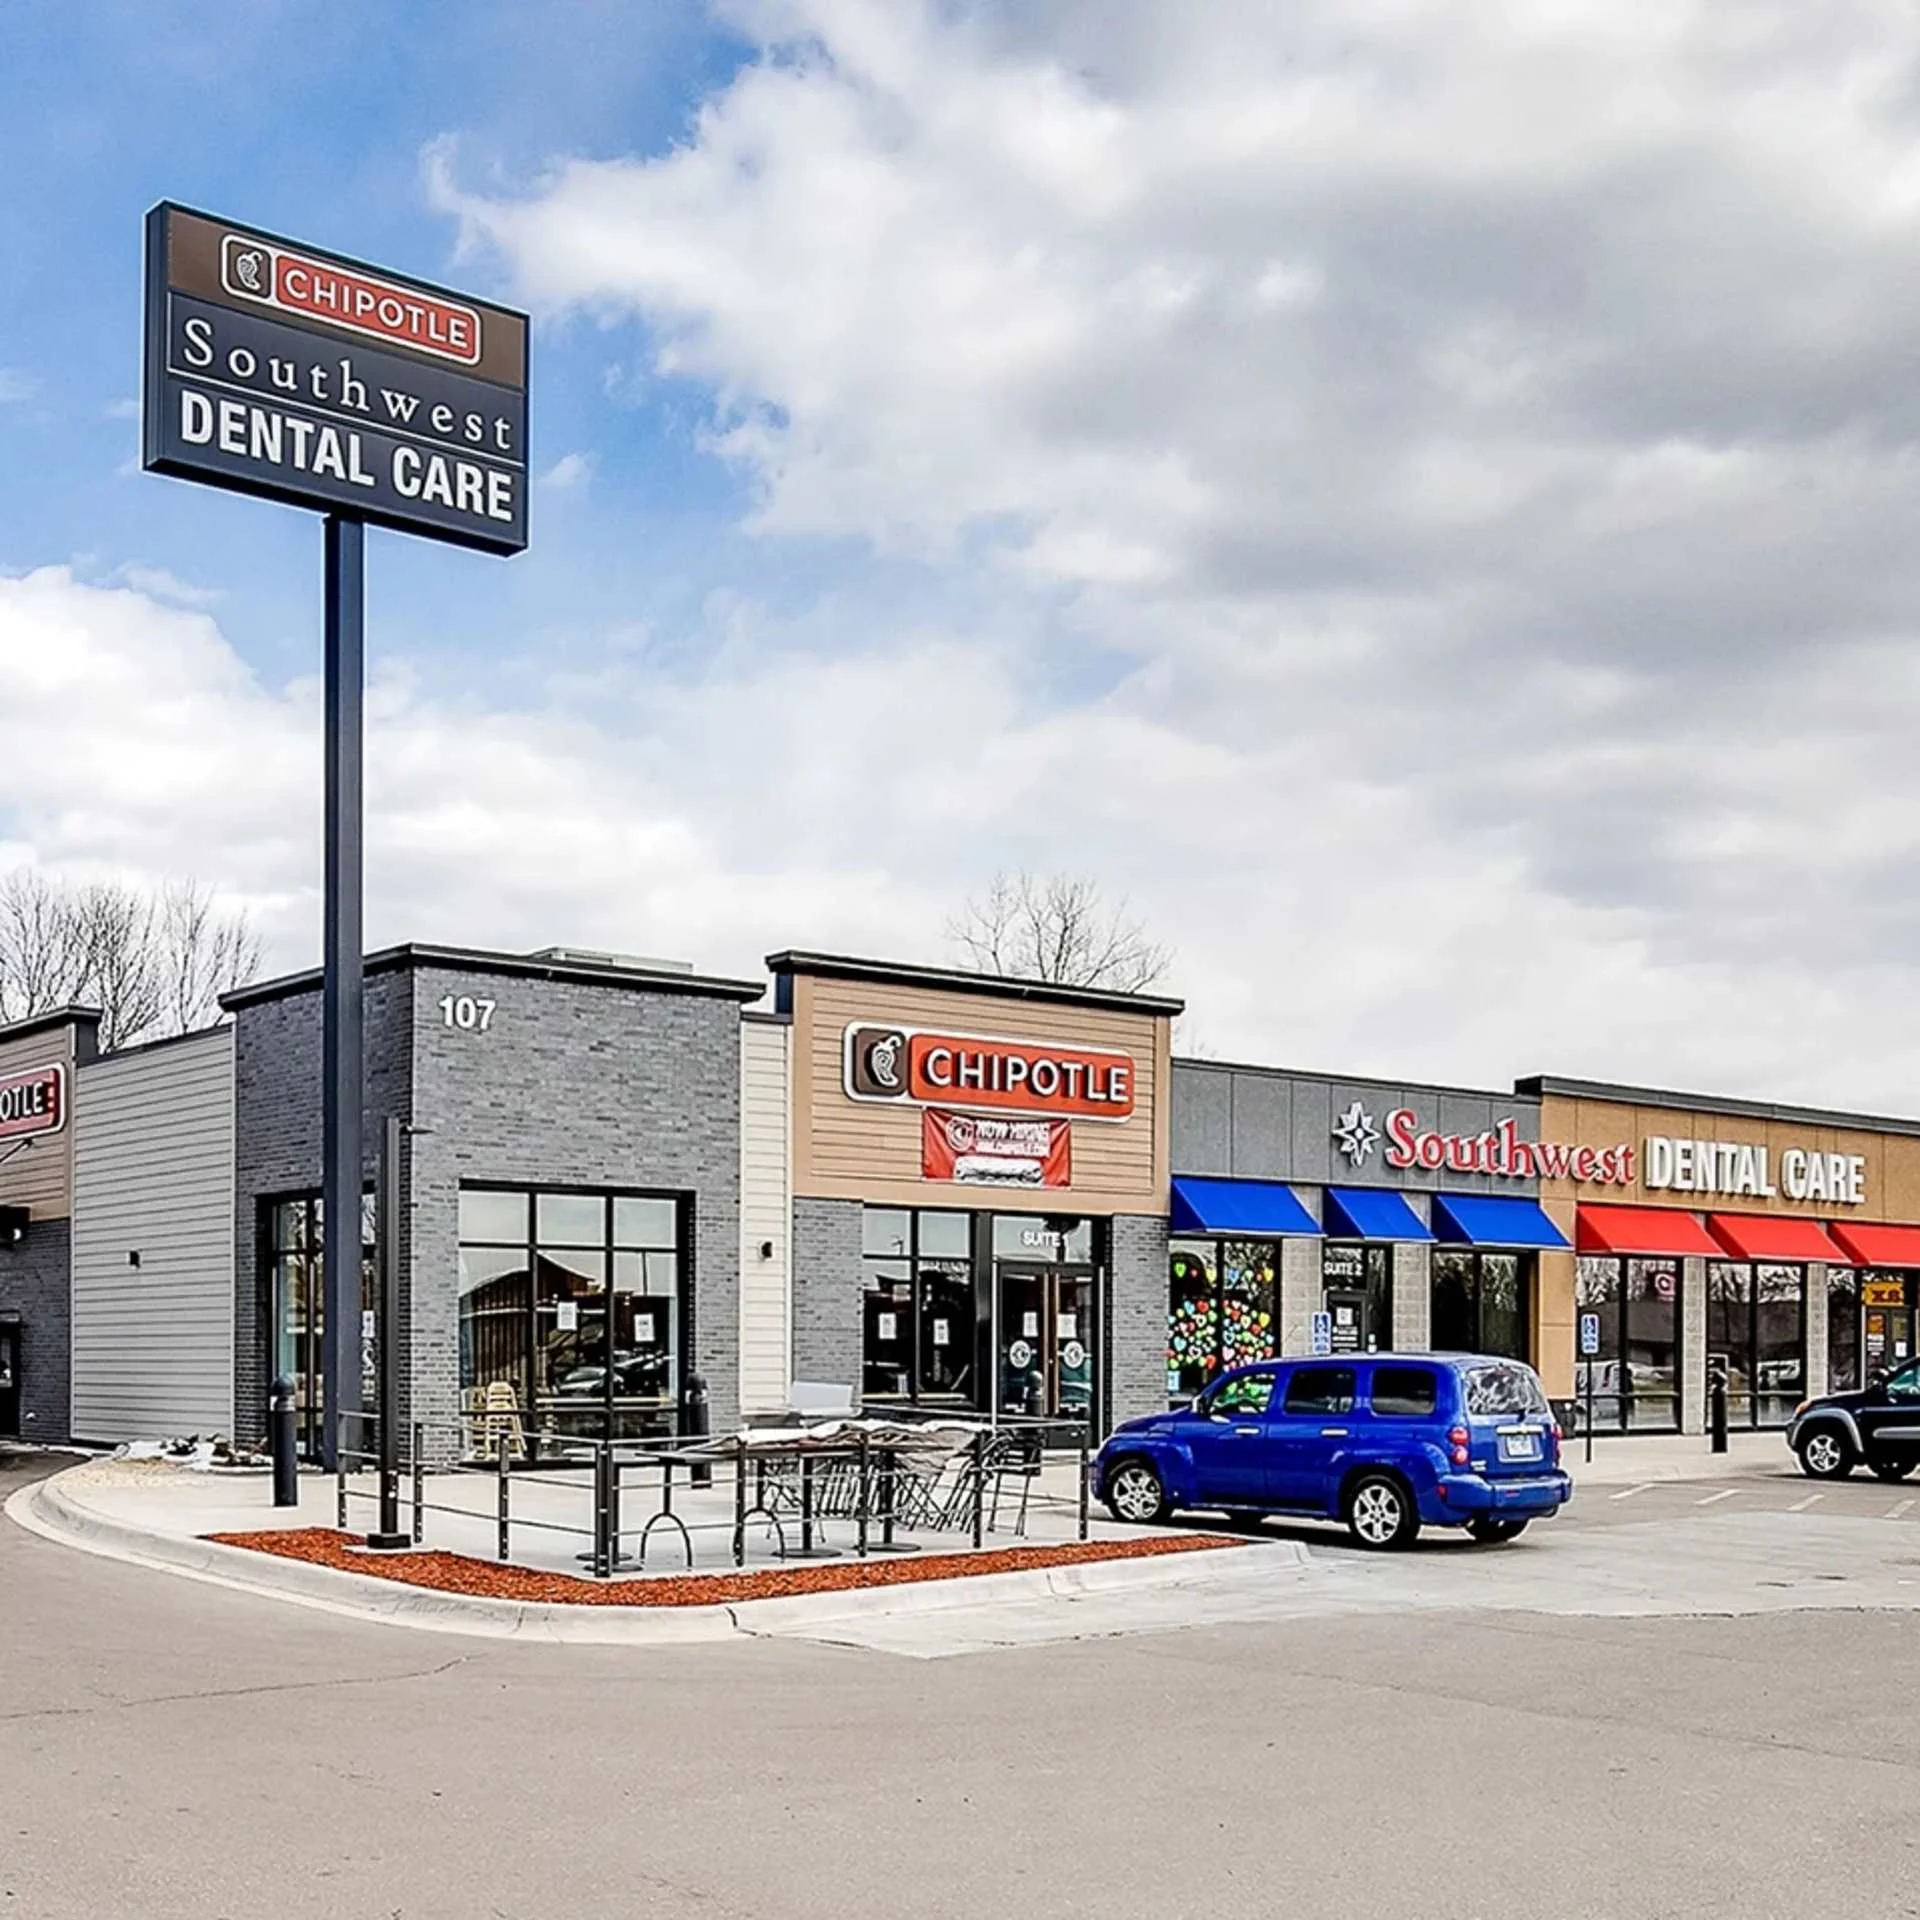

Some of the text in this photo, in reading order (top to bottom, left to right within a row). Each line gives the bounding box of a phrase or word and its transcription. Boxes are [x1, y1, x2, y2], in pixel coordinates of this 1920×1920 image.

[284, 267, 469, 349] CHIPOTLE
[183, 318, 511, 450] Southwest
[182, 390, 513, 522] DENTAL CARE
[439, 995, 496, 1029] 107
[927, 1048, 1129, 1101] CHIPOTLE
[1385, 1108, 1865, 1204] Southwest DENTAL CARE
[1022, 1229, 1060, 1248] SUITE
[1324, 1261, 1363, 1276] SUITE 2
